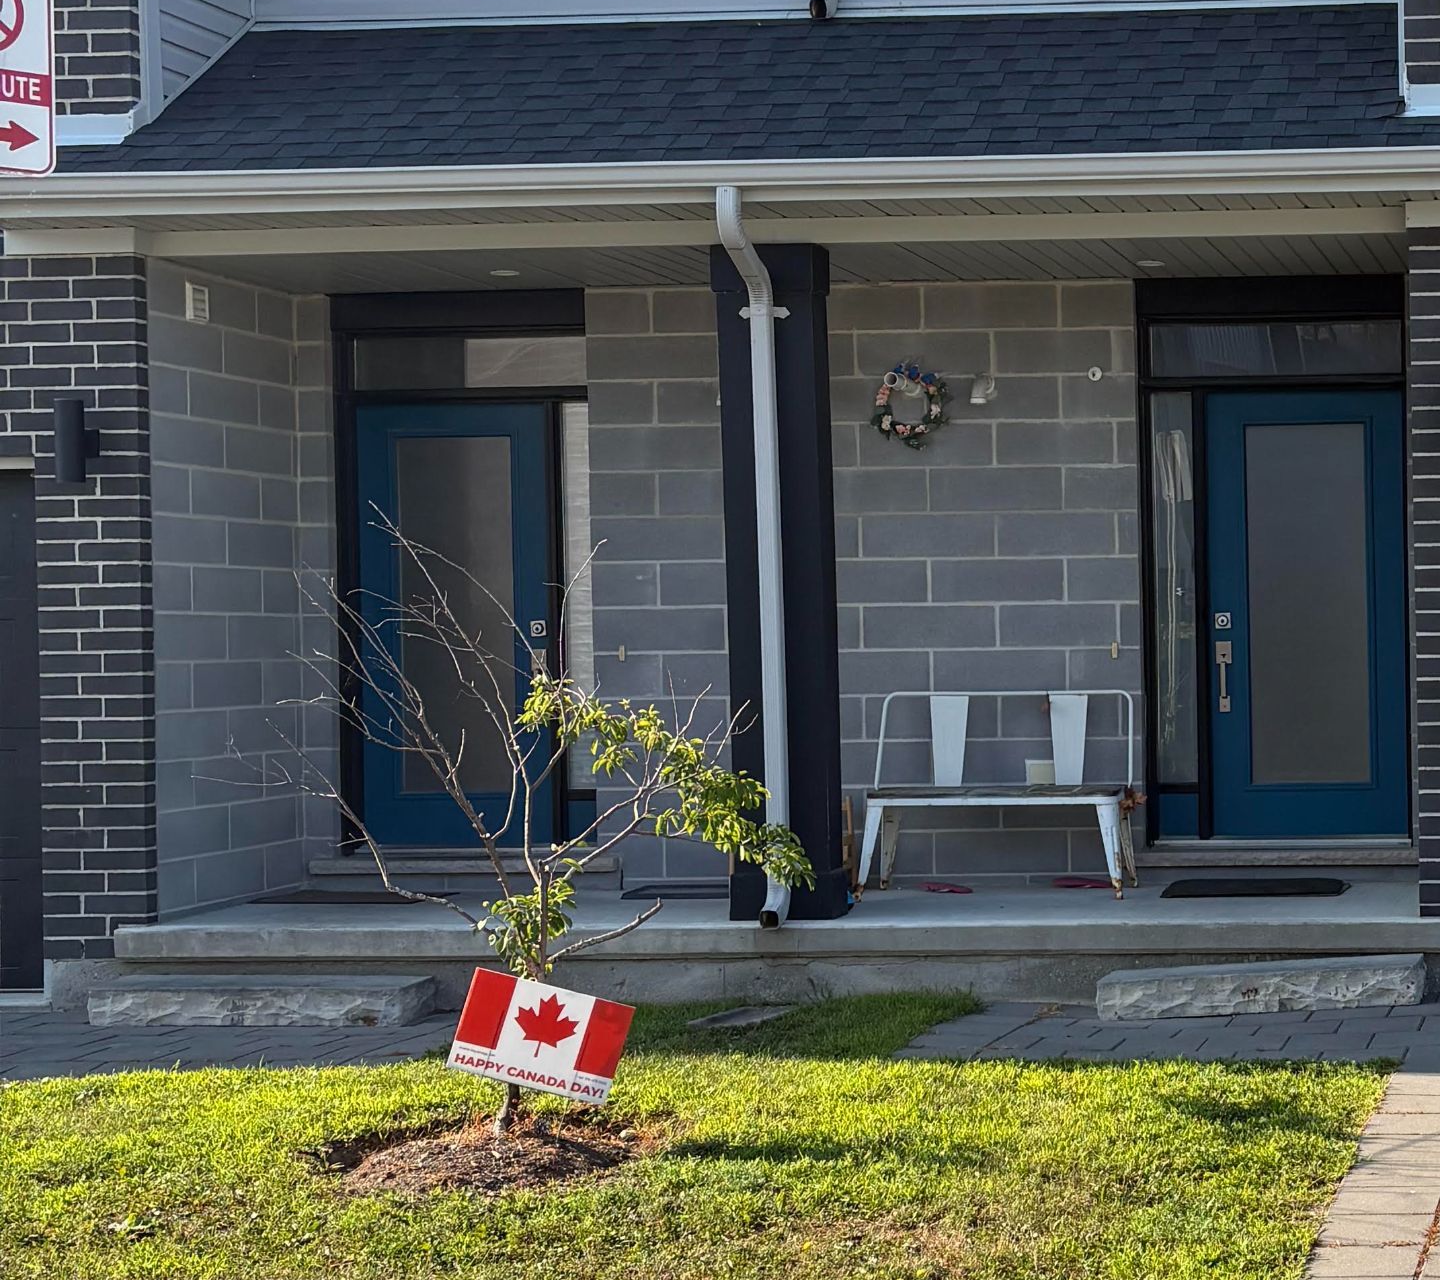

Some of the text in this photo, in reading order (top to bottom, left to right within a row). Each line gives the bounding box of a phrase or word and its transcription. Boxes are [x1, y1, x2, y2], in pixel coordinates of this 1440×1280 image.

[454, 1053, 504, 1073] HAPPY
[507, 1067, 567, 1090] CANADA
[570, 1082, 604, 1098] DAY!
